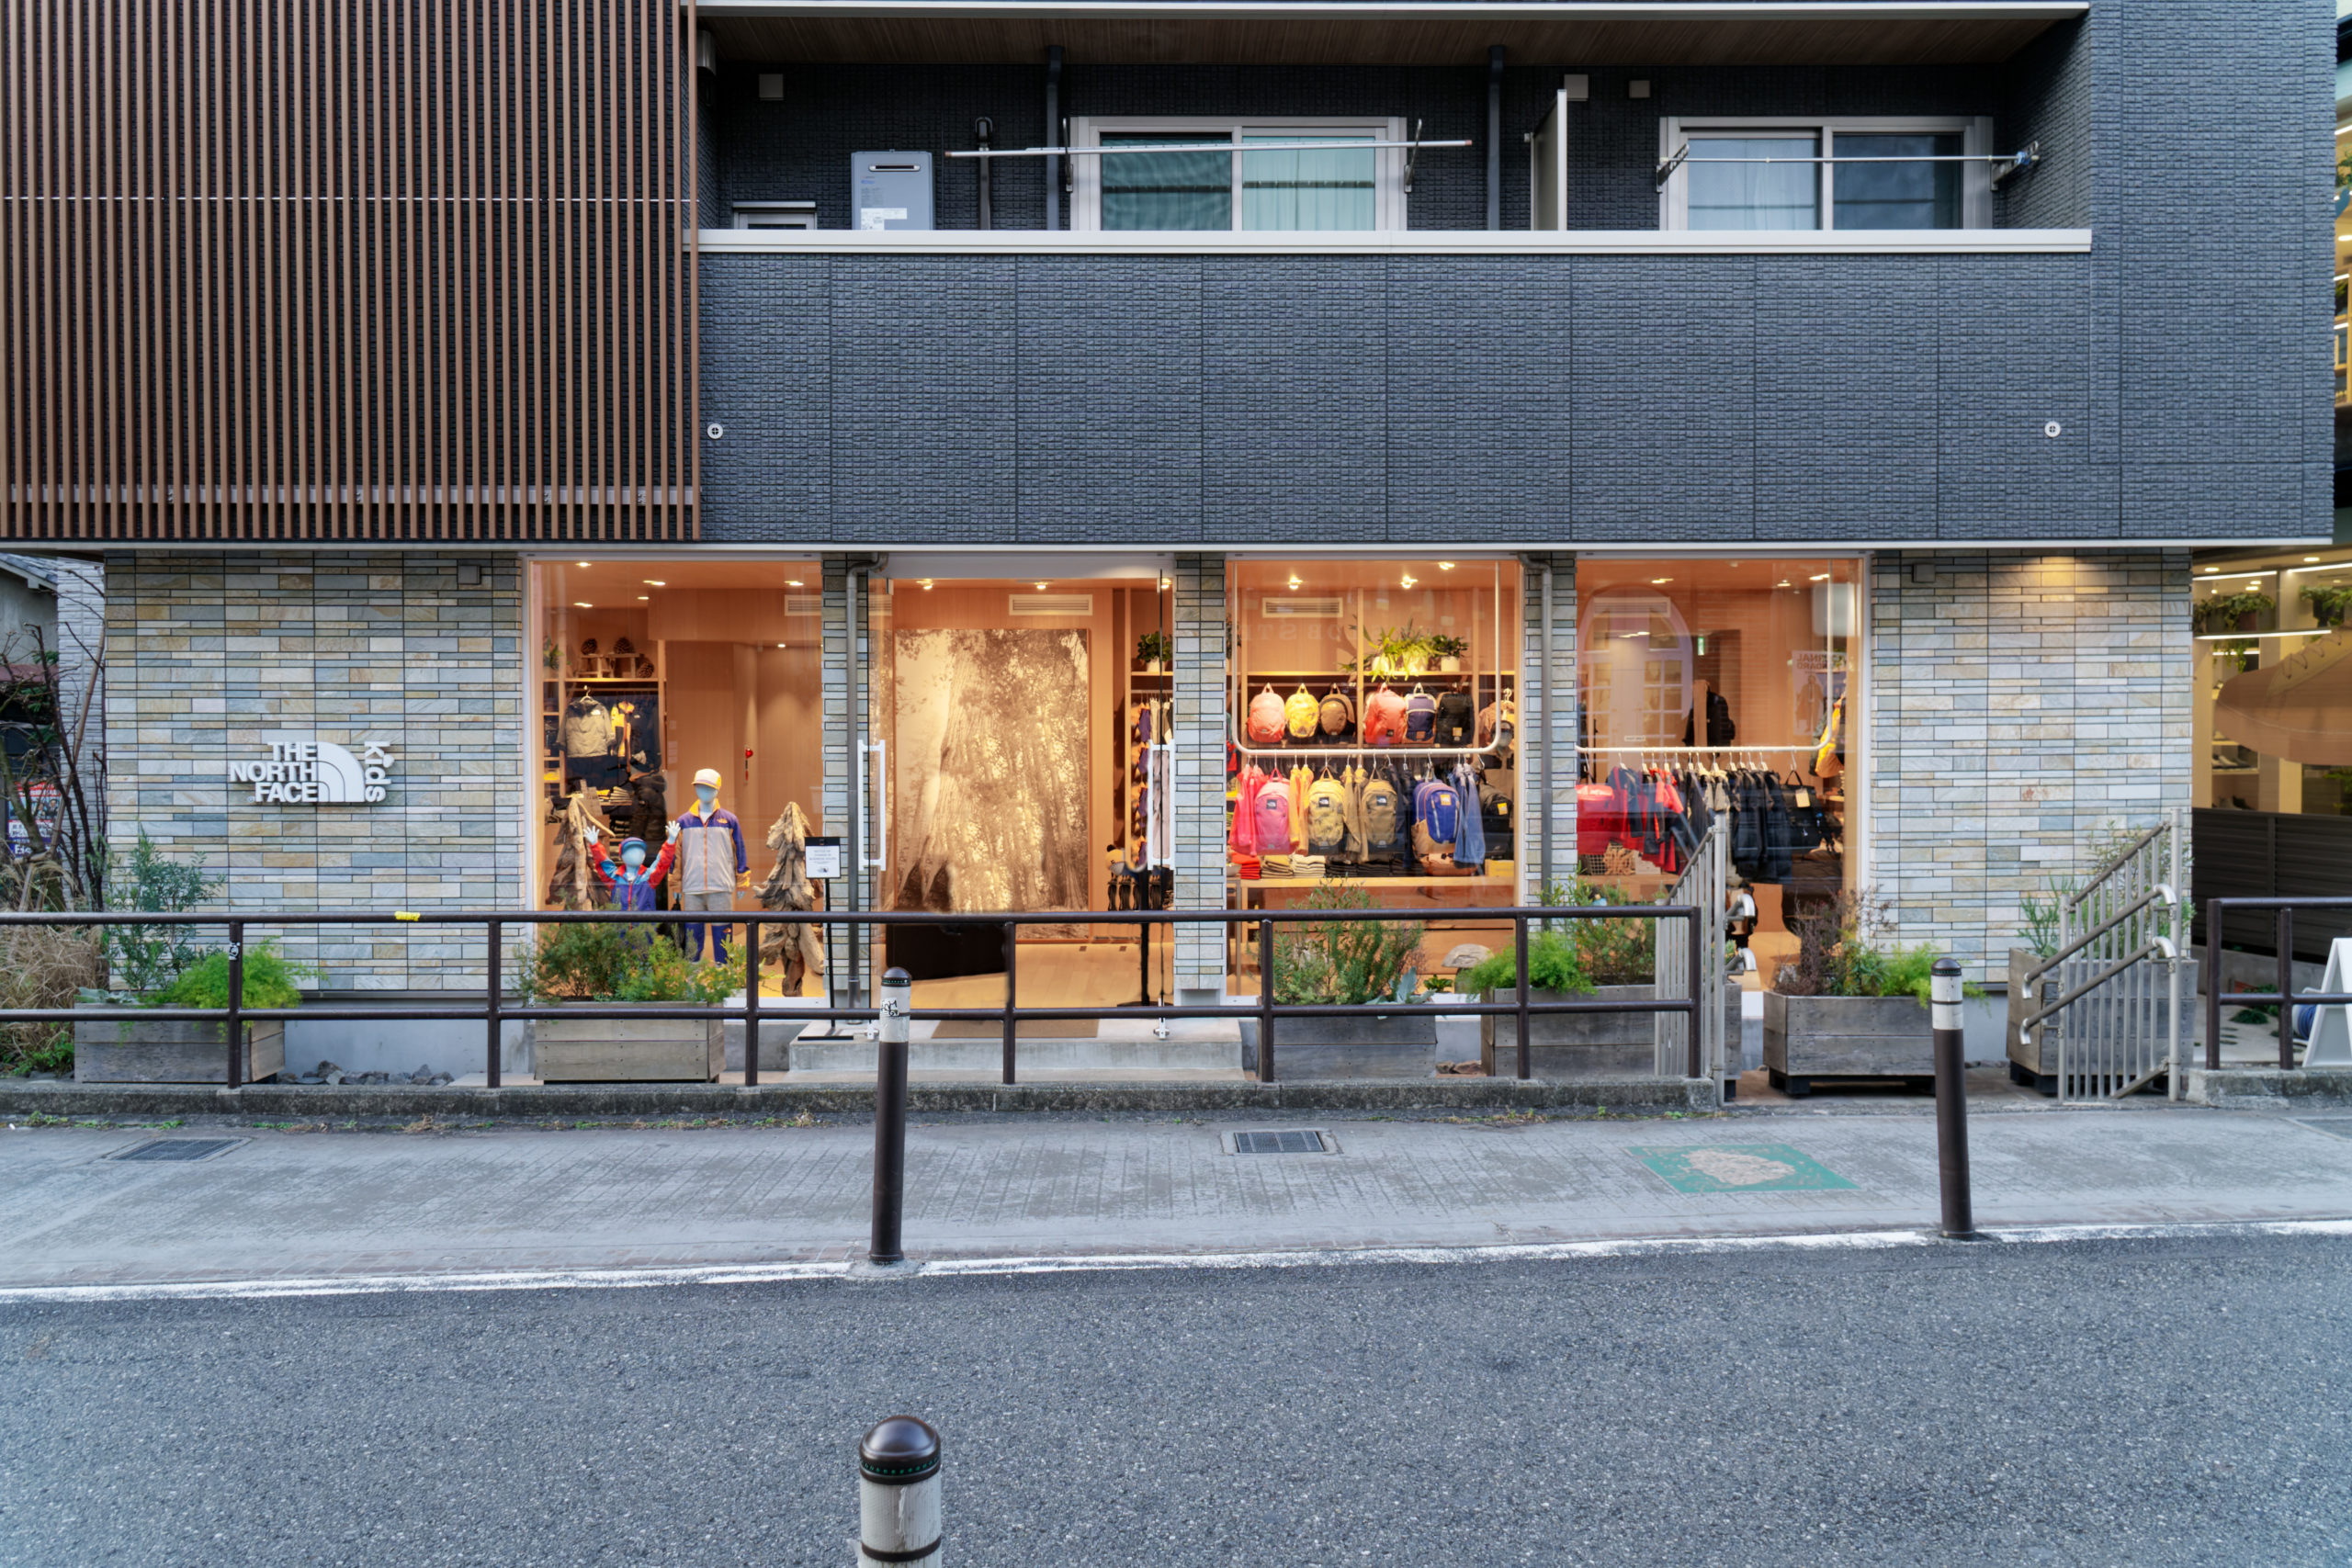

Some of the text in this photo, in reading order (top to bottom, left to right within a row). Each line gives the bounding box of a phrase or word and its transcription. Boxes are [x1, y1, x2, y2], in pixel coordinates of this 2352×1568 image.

[267, 741, 318, 761] THE
[230, 761, 318, 782] NORTH
[364, 741, 395, 802] kids
[255, 782, 318, 803] FACE
